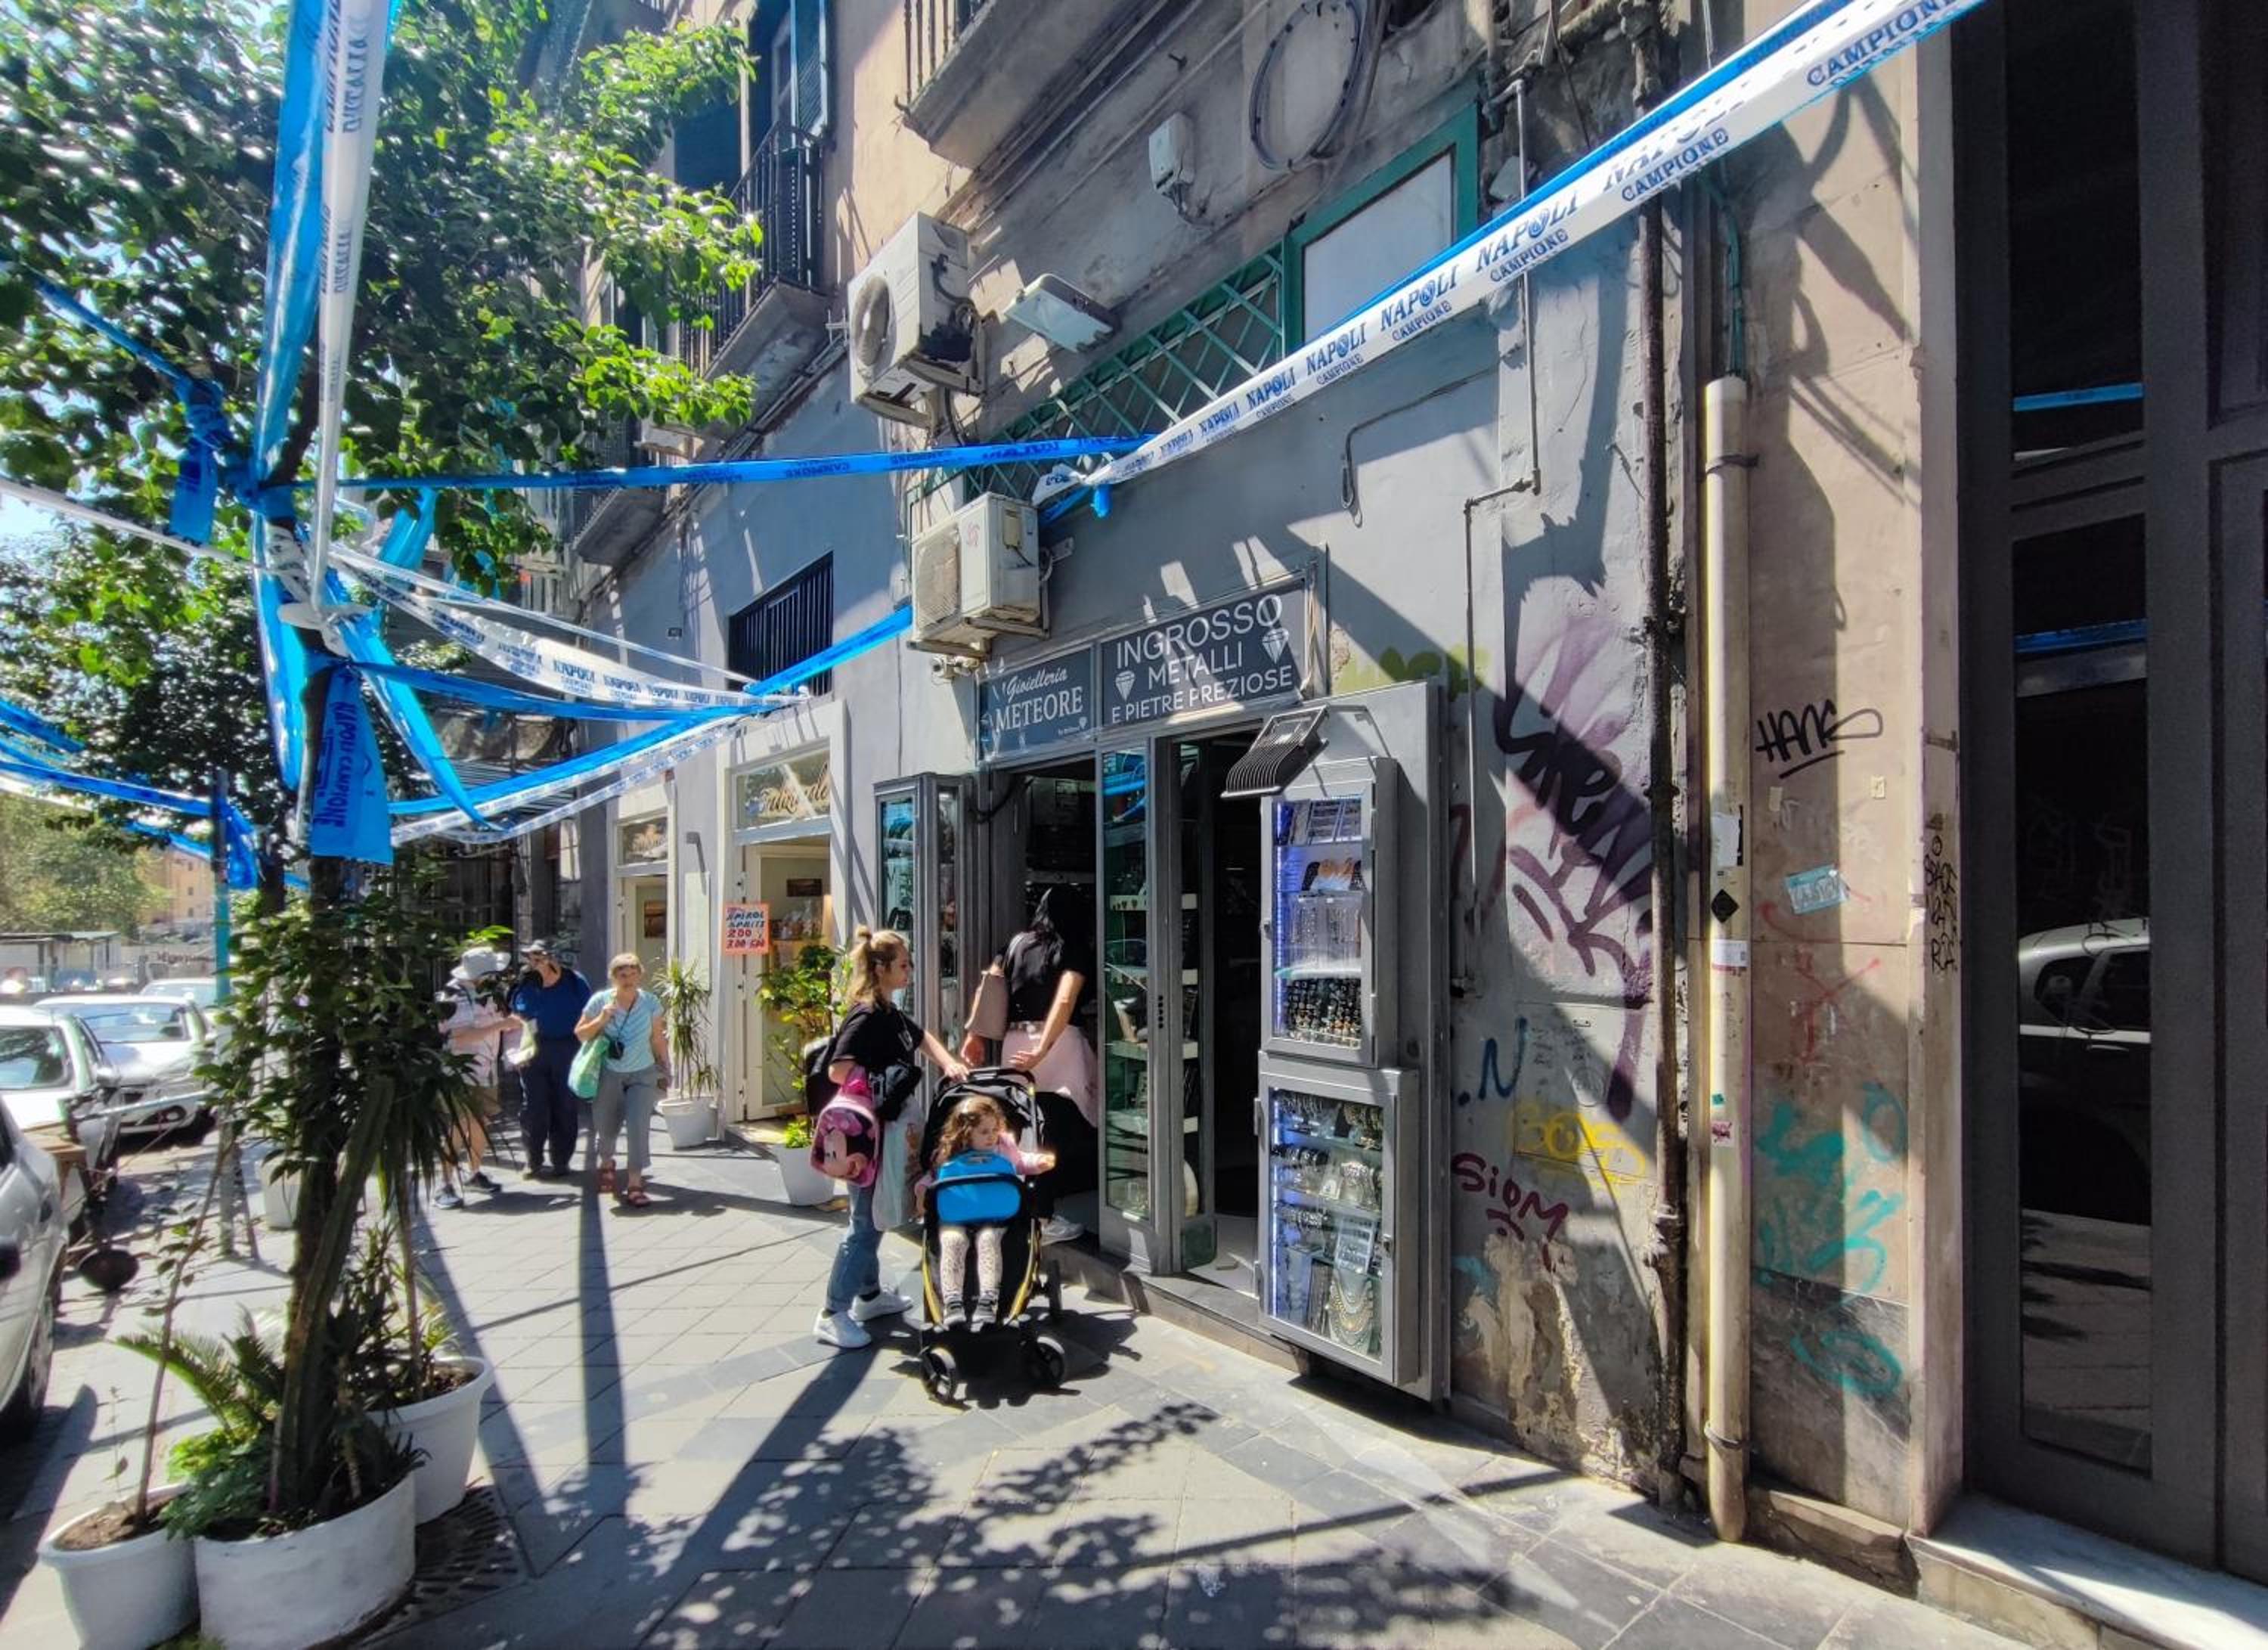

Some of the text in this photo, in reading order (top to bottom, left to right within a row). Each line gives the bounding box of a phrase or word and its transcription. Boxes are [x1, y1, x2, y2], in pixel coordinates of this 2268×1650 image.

[1807, 0, 1957, 87] CAMPION
[1622, 127, 1729, 201] CAMPIONE
[1475, 191, 1579, 272] NAPOLI
[1490, 228, 1569, 283] CAMPIONE
[1380, 265, 1458, 331] NAPOLI
[1392, 300, 1452, 342] CAMPIONE
[1306, 322, 1366, 376] NAPOLI
[1316, 353, 1364, 386] CAMPIONE
[1246, 367, 1295, 410] NAPOLI
[1116, 594, 1283, 670] INGROSSO
[1006, 666, 1067, 696] Gioielleria
[1148, 640, 1243, 690] METALLI
[995, 686, 1083, 733] METEORE
[1111, 665, 1293, 724] E PIETRE PREZIOSE
[330, 702, 358, 752] NAPOLI
[313, 757, 353, 828] CAMPIONE
